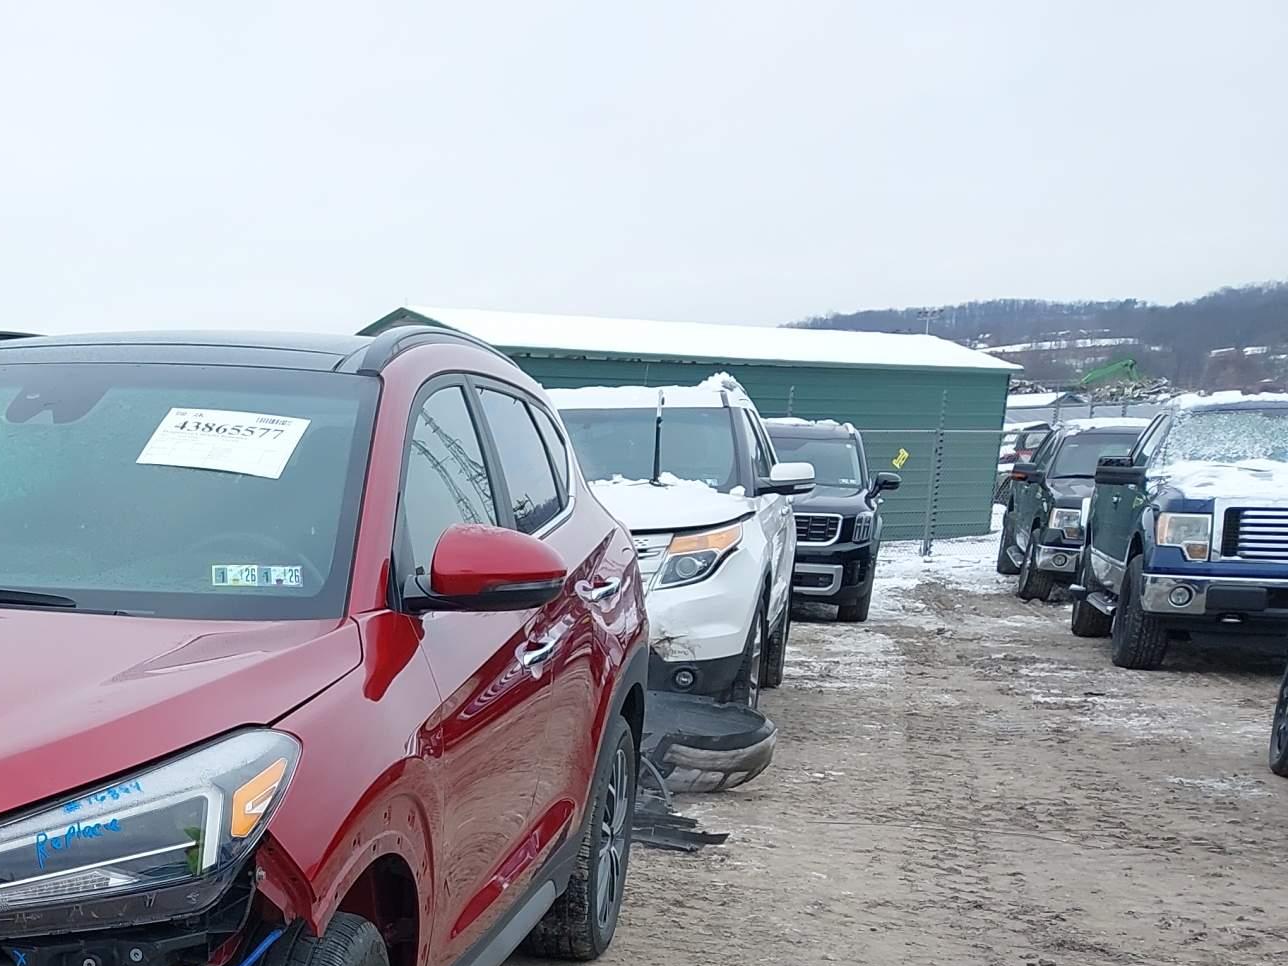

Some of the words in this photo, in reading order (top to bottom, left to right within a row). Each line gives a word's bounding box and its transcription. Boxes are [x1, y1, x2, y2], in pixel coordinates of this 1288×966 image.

[174, 420, 285, 440] 43865577
[244, 567, 257, 582] 26
[288, 568, 300, 584] 26
